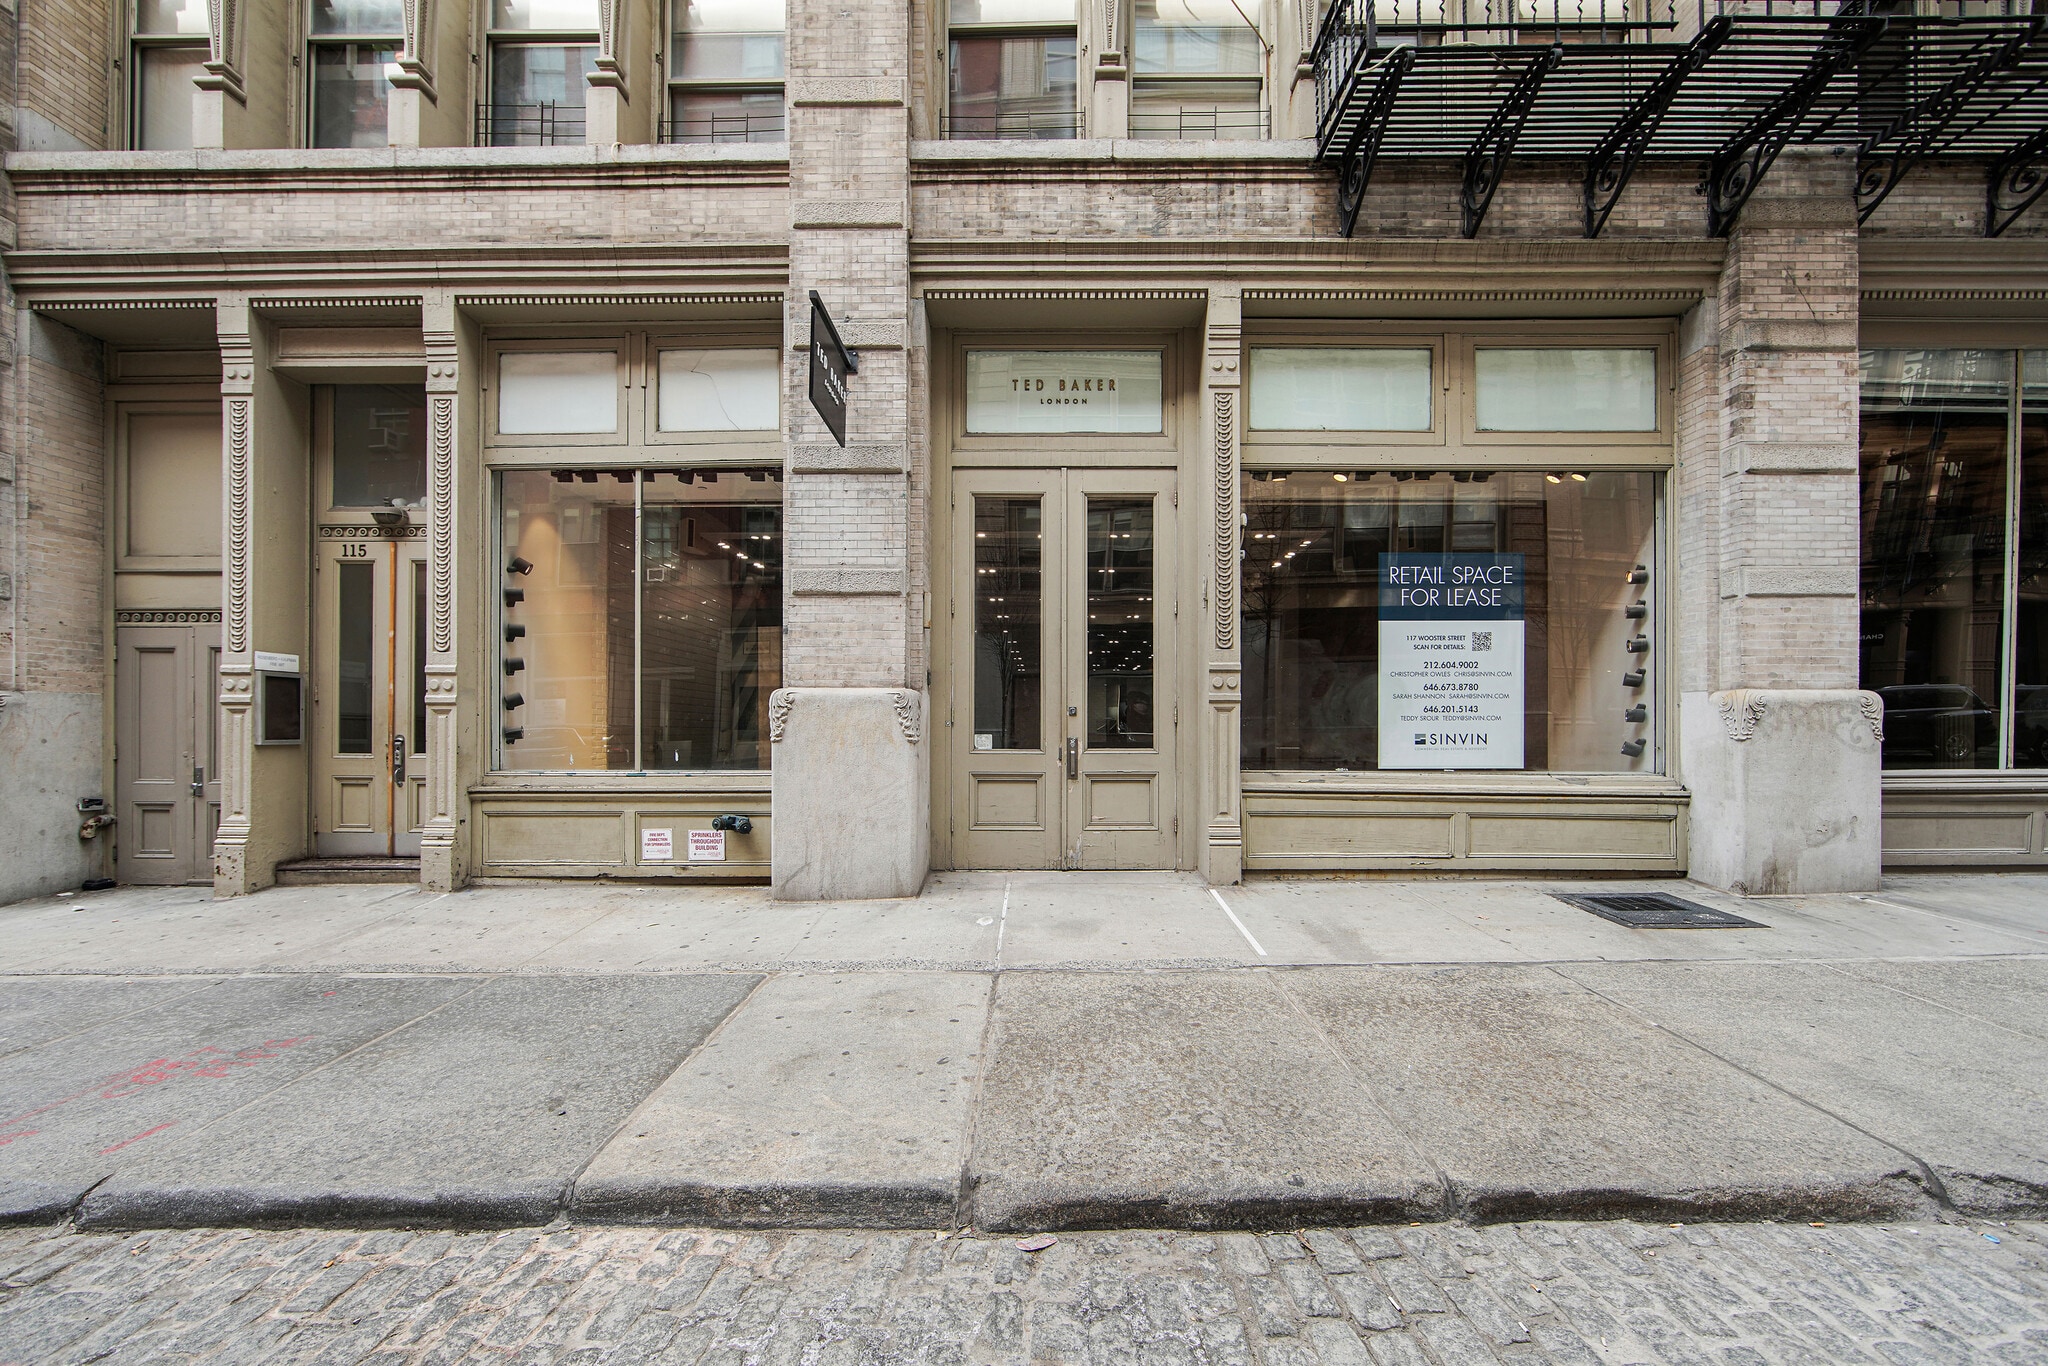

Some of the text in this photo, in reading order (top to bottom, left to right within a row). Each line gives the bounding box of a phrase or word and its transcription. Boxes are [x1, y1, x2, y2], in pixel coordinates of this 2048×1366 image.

[816, 341, 828, 370] TED
[1012, 378, 1116, 391] TED BAKER
[342, 544, 367, 557] 115
[1389, 566, 1513, 585] RETAIL SPACE
[1401, 588, 1501, 607] FOR LEASE
[1423, 661, 1479, 669] 212.604.9002
[1423, 683, 1479, 691] 646.673.8780
[1423, 705, 1479, 713] 646.201.5143
[1429, 733, 1488, 745] SINVIN
